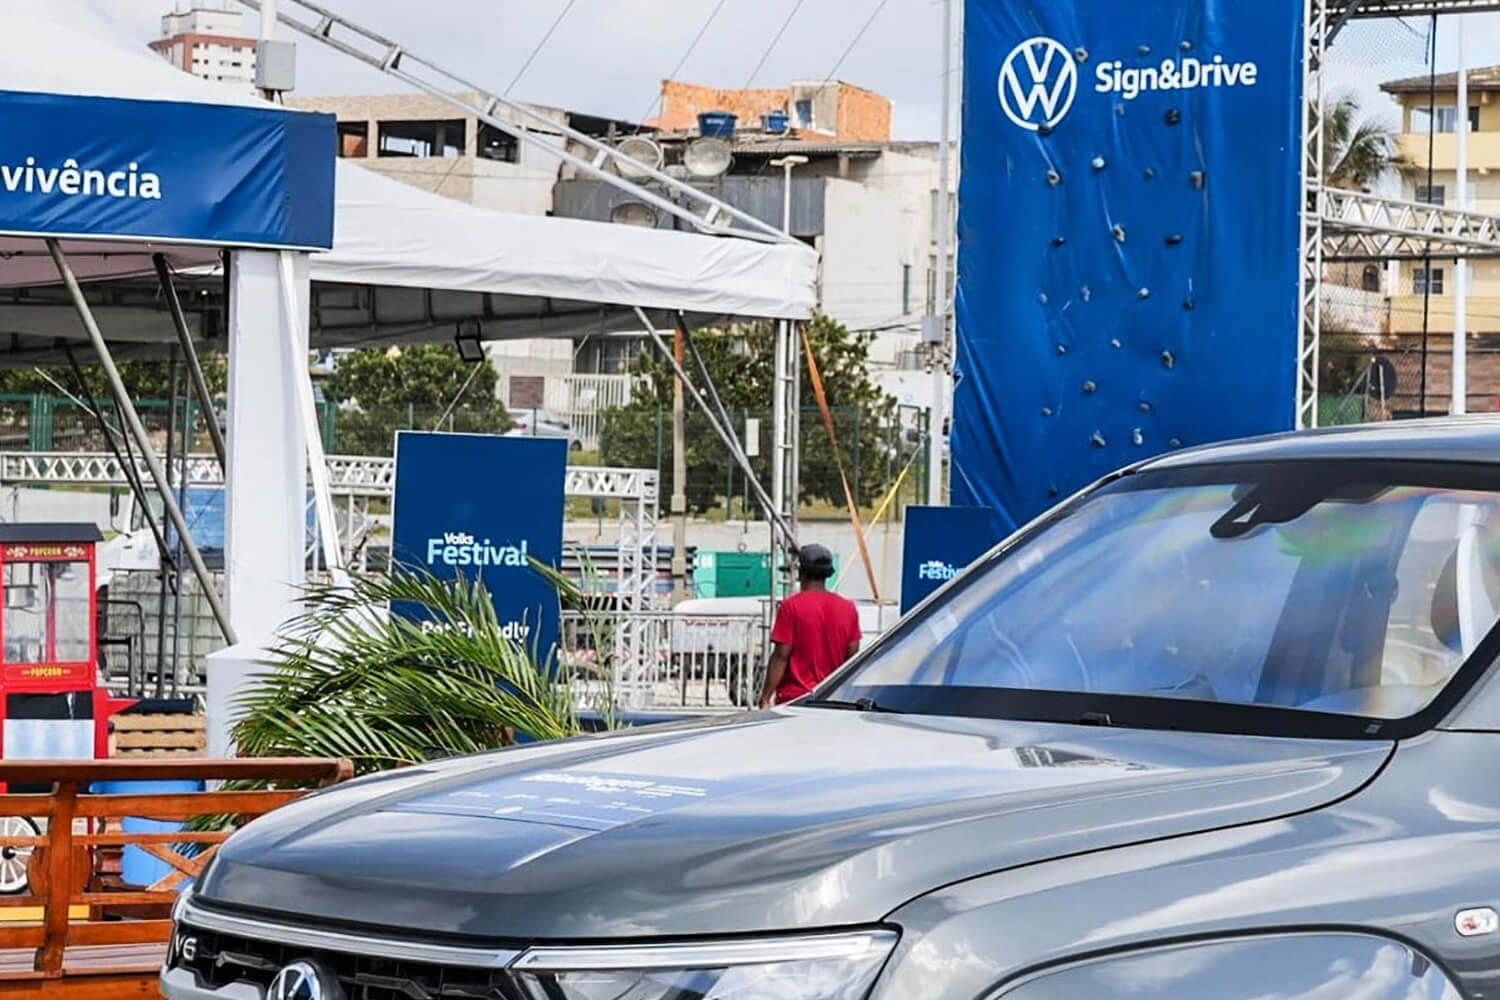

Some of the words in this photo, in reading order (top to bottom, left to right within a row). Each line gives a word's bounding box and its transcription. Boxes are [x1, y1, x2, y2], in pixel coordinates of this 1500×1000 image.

[1095, 55, 1258, 100] Sign&Drive
[1, 157, 161, 199] vivência
[427, 538, 529, 566] Festival
[919, 564, 966, 579] Festiv
[458, 620, 529, 643] Frdly
[175, 933, 197, 961] V6
